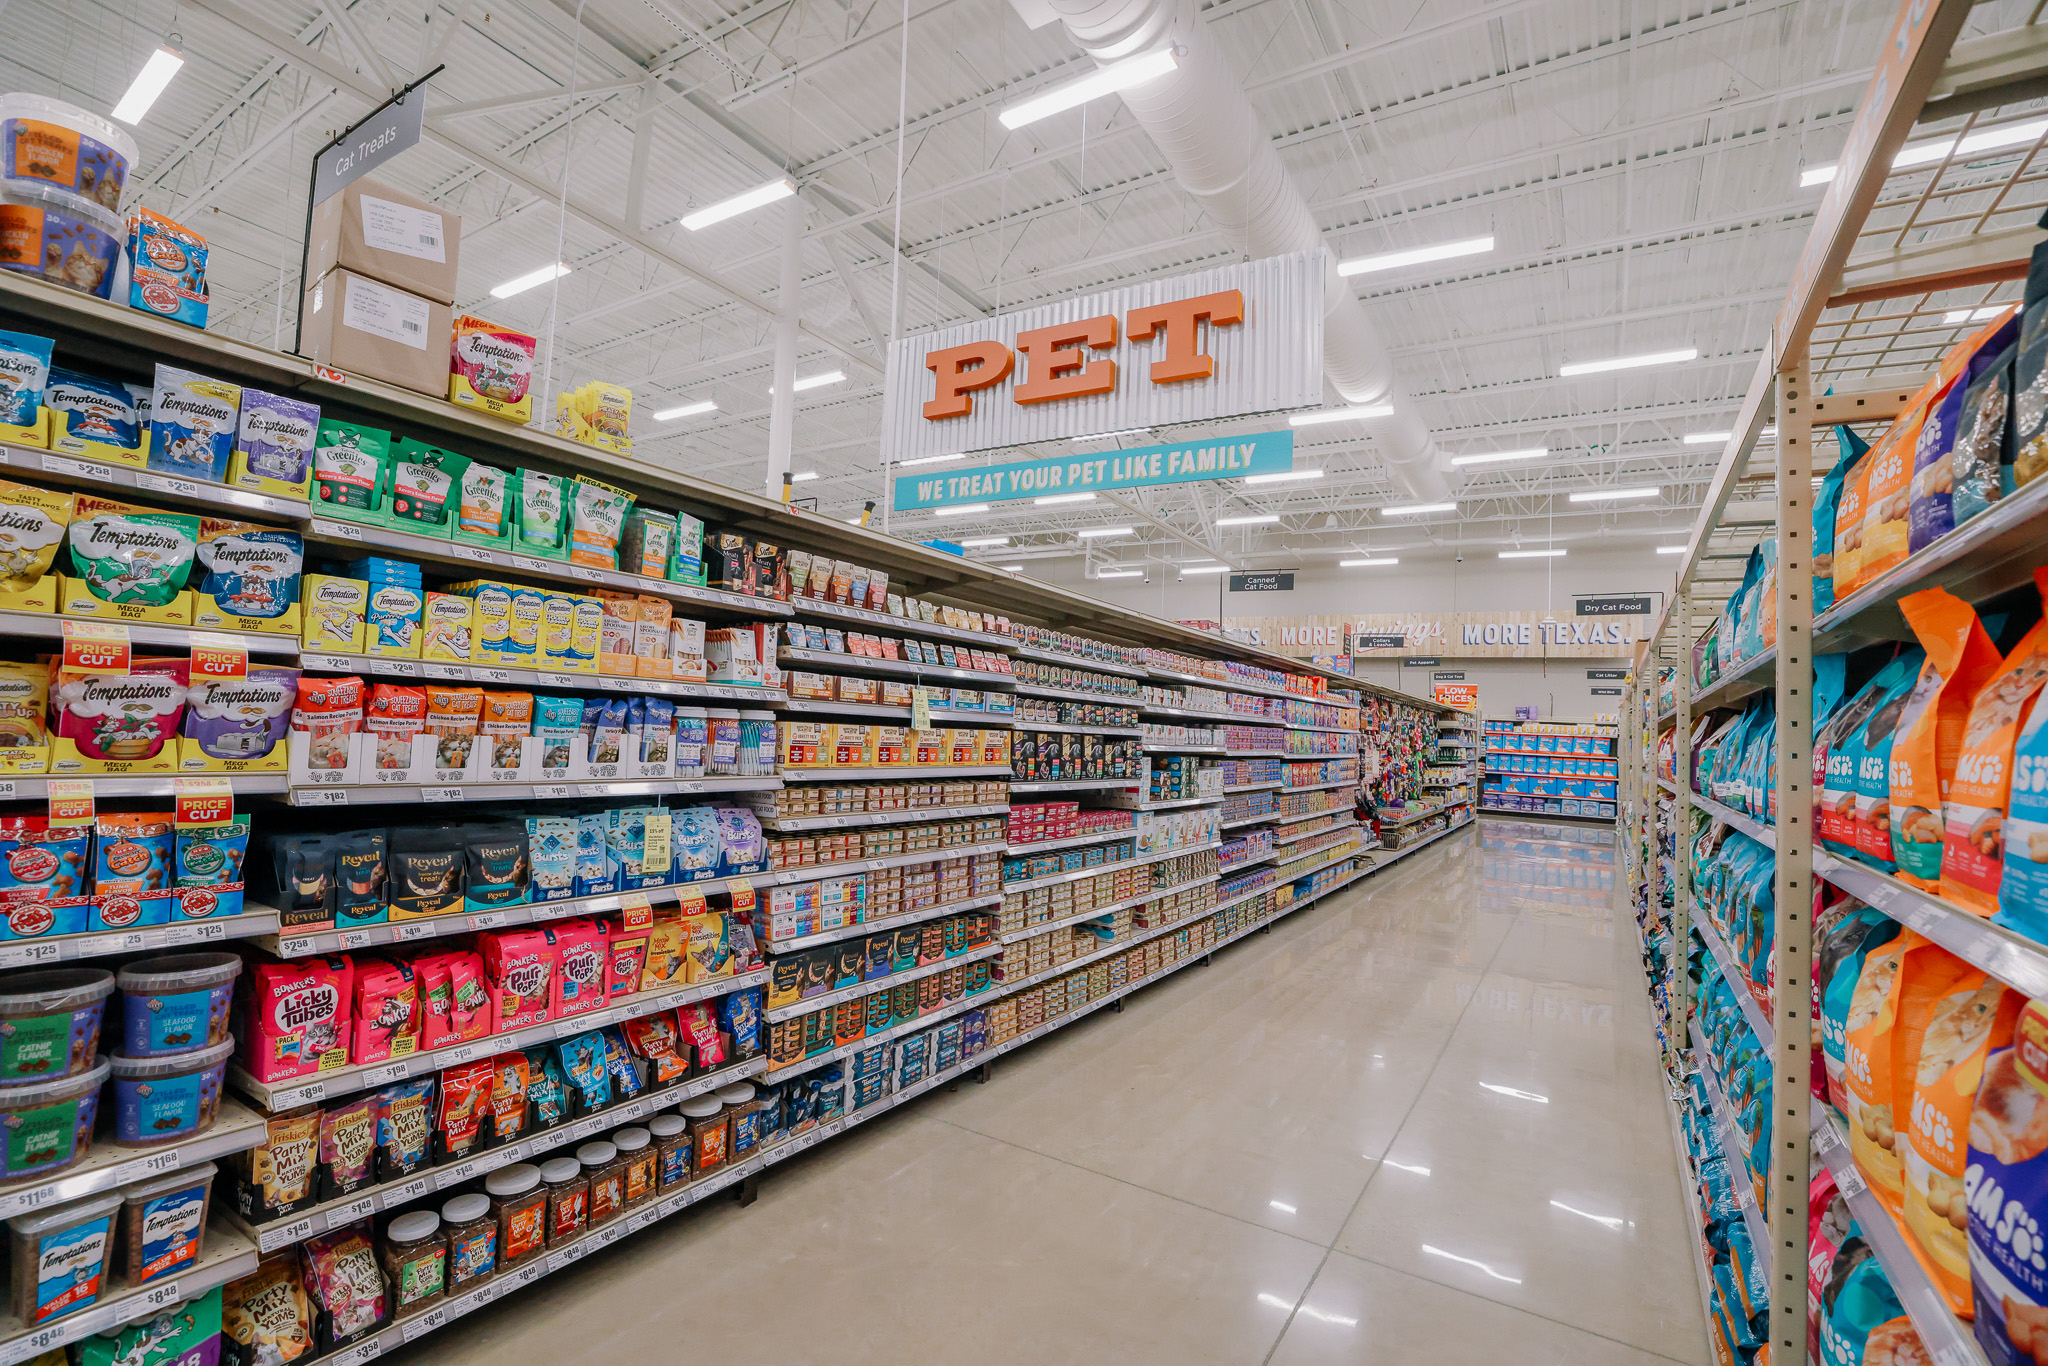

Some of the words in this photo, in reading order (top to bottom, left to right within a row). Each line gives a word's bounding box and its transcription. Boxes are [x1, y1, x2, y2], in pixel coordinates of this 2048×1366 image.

[82, 137, 95, 148] 30
[26, 144, 64, 160] CHICKEN
[335, 153, 354, 177] Cat
[359, 125, 397, 162] Treats
[28, 152, 60, 166] FLAVOR
[469, 336, 524, 363] Temptations
[923, 288, 1243, 421] PET
[52, 389, 127, 414] Temptations
[160, 391, 229, 421] Temptations
[486, 398, 504, 409] MEGA
[327, 451, 368, 466] Greenies
[406, 465, 442, 483] Greenies
[917, 480, 943, 502] WE
[948, 472, 1005, 498] TREAT
[1009, 465, 1062, 491] YOUR
[1068, 459, 1108, 488] PET
[1111, 452, 1162, 481] LIKE
[1168, 442, 1257, 474] FAMILY
[579, 477, 601, 488] MEGA
[613, 488, 631, 499] SIZE
[1878, 478, 1901, 491] HEALTH
[18, 494, 41, 502] TASTY
[465, 485, 502, 502] Greenies
[77, 498, 117, 516] MEGA
[582, 508, 618, 526] Greenies
[91, 522, 180, 553] Temptations
[214, 542, 289, 564] Temptations
[1247, 576, 1276, 584] Canned
[378, 594, 415, 607] Temptations
[1585, 604, 1600, 612] Dry
[1618, 603, 1642, 611] Food
[120, 611, 141, 619] BAG
[1280, 626, 1338, 646] MORE
[1463, 623, 1531, 645] MORE
[1538, 621, 1632, 645] TEXAS.
[71, 644, 123, 656] PRICE
[78, 653, 115, 666] CUT
[197, 652, 241, 664] PRICE
[203, 662, 235, 673] CUT
[83, 678, 173, 706] Temptations
[206, 683, 282, 705] Temptations
[1444, 687, 1468, 696] LOW
[390, 695, 421, 705] SQUEEZABLE
[1438, 695, 1474, 703] PRICES
[391, 703, 401, 712] CAT
[402, 702, 419, 712] TREATS
[326, 712, 343, 720] Recipe
[1834, 777, 1852, 785] HEALTH
[53, 801, 90, 810] PRICE
[182, 800, 227, 810] PRICE
[59, 808, 84, 817] CUT
[190, 809, 220, 820] CUT
[676, 835, 709, 846] Bursts
[726, 830, 756, 842] Bursts
[481, 845, 519, 860] Reveal
[533, 851, 569, 863] Bursts
[110, 852, 149, 870] Catch
[186, 853, 222, 868] Catch
[342, 851, 380, 869] Reveal
[407, 855, 452, 871] Reveal
[734, 892, 753, 900] PRICE
[736, 897, 750, 906] CUT
[683, 900, 703, 909] PRICE
[687, 905, 701, 914] CUT
[285, 909, 329, 924] Reveal
[626, 908, 649, 918] PRICE
[630, 914, 646, 924] CUT
[506, 953, 538, 969] BONKERS
[568, 957, 597, 974] Purr
[574, 968, 593, 980] Pops
[777, 962, 798, 975] Reveal
[510, 966, 542, 986] Purr
[273, 976, 316, 998] BONKERS
[517, 979, 538, 993] Pops
[284, 989, 333, 1013] Licky
[563, 1001, 590, 1015] BONKERS
[162, 1016, 196, 1026] SEAFOOD
[281, 1003, 334, 1029] Tubes
[502, 1015, 532, 1031] BONKERS
[164, 1023, 193, 1032] FLAVOR
[17, 1041, 52, 1054] CATNIP
[17, 1048, 52, 1060] FLAVOR
[267, 1067, 297, 1082] BONKERS
[152, 1101, 186, 1111] SEAFOOD
[391, 1097, 422, 1112] Friskies
[154, 1107, 183, 1118] FLAVOR
[336, 1110, 368, 1127] Friskies
[390, 1108, 424, 1126] Party
[397, 1118, 423, 1136] Mix
[445, 1117, 470, 1130] Party
[273, 1128, 308, 1145] Friskies
[342, 1134, 366, 1149] Mix
[269, 1141, 309, 1165] Party
[1921, 1138, 1955, 1168] HEALTH
[276, 1156, 305, 1176] Mix
[329, 1158, 346, 1168] WILD
[281, 1164, 306, 1178] NATURAL
[173, 1246, 188, 1258] 16
[147, 1254, 173, 1272] VALUE
[1992, 1242, 2045, 1293] HEALTH
[74, 1282, 89, 1296] 16
[43, 1292, 72, 1311] VALUE
[240, 1283, 294, 1312] Party
[252, 1296, 289, 1323] Mix
[260, 1310, 296, 1330] YUMS
[237, 1327, 249, 1337] NO
